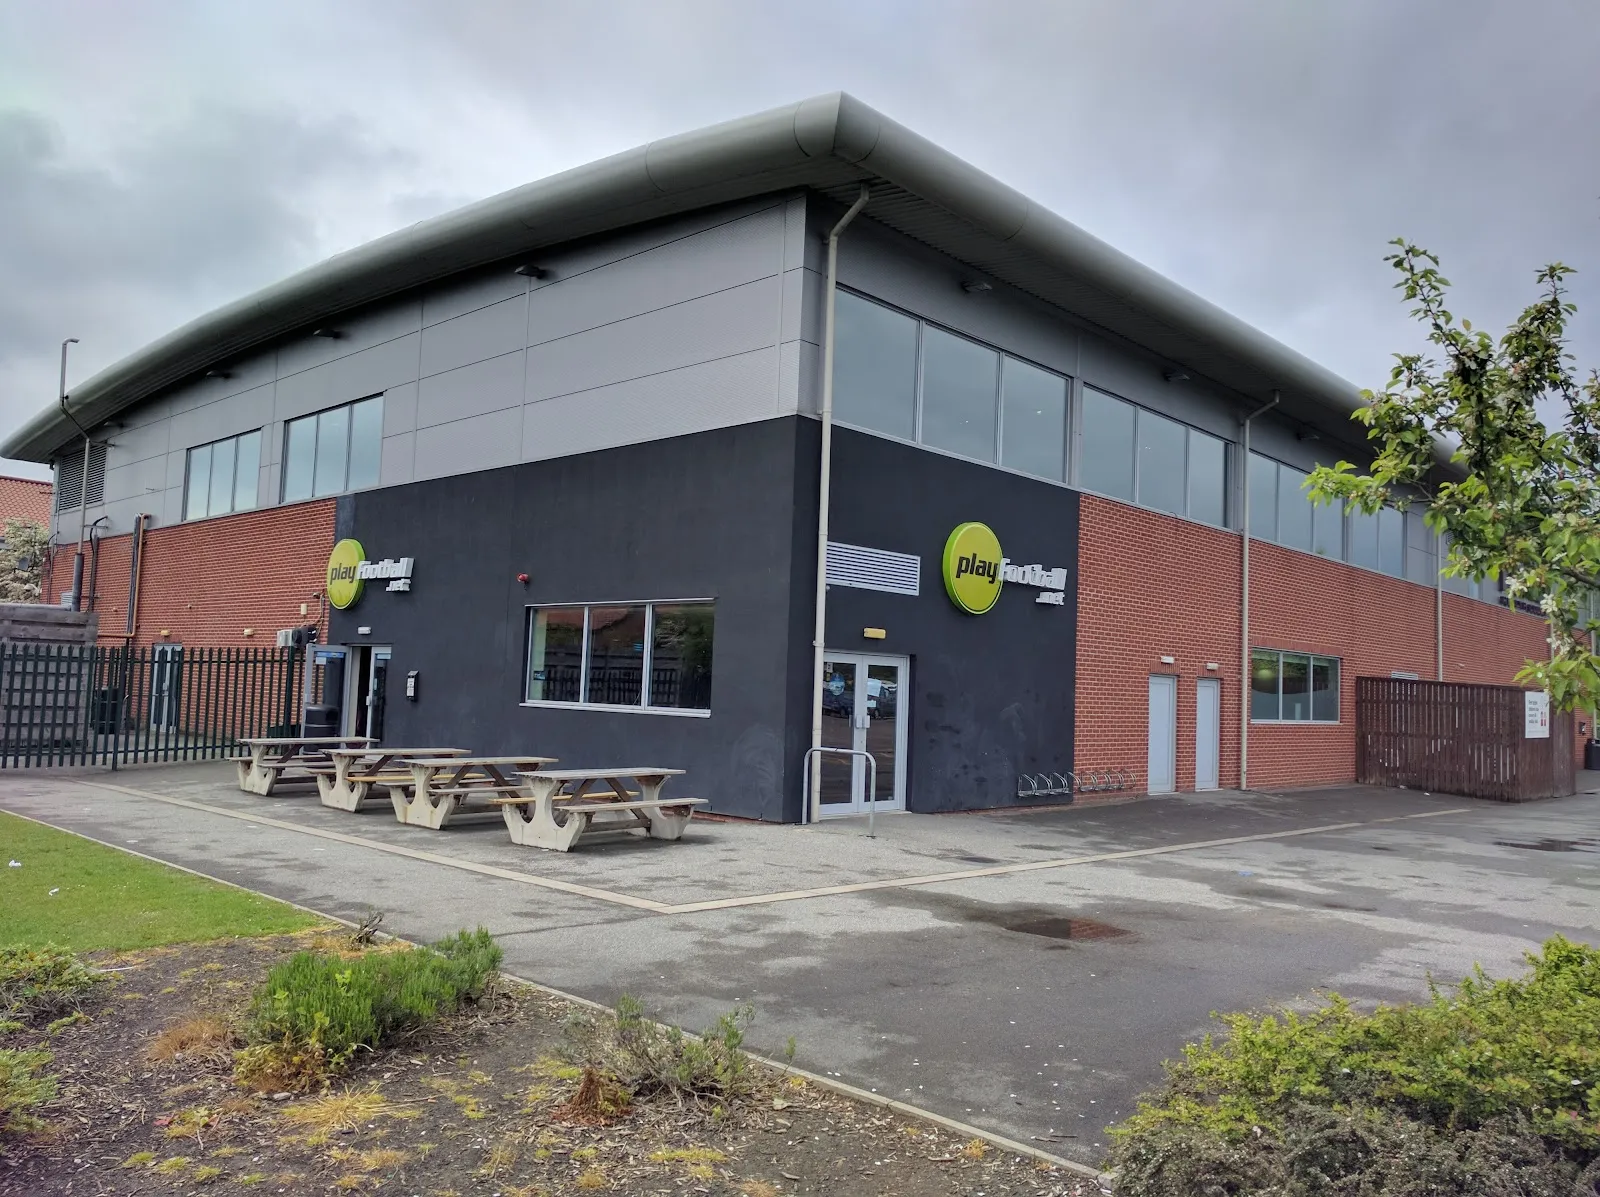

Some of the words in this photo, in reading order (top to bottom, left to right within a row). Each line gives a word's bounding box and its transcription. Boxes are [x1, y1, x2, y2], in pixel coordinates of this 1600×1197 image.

[330, 562, 356, 585] play
[358, 557, 414, 580] football
[956, 552, 998, 584] play
[998, 557, 1067, 590] football
